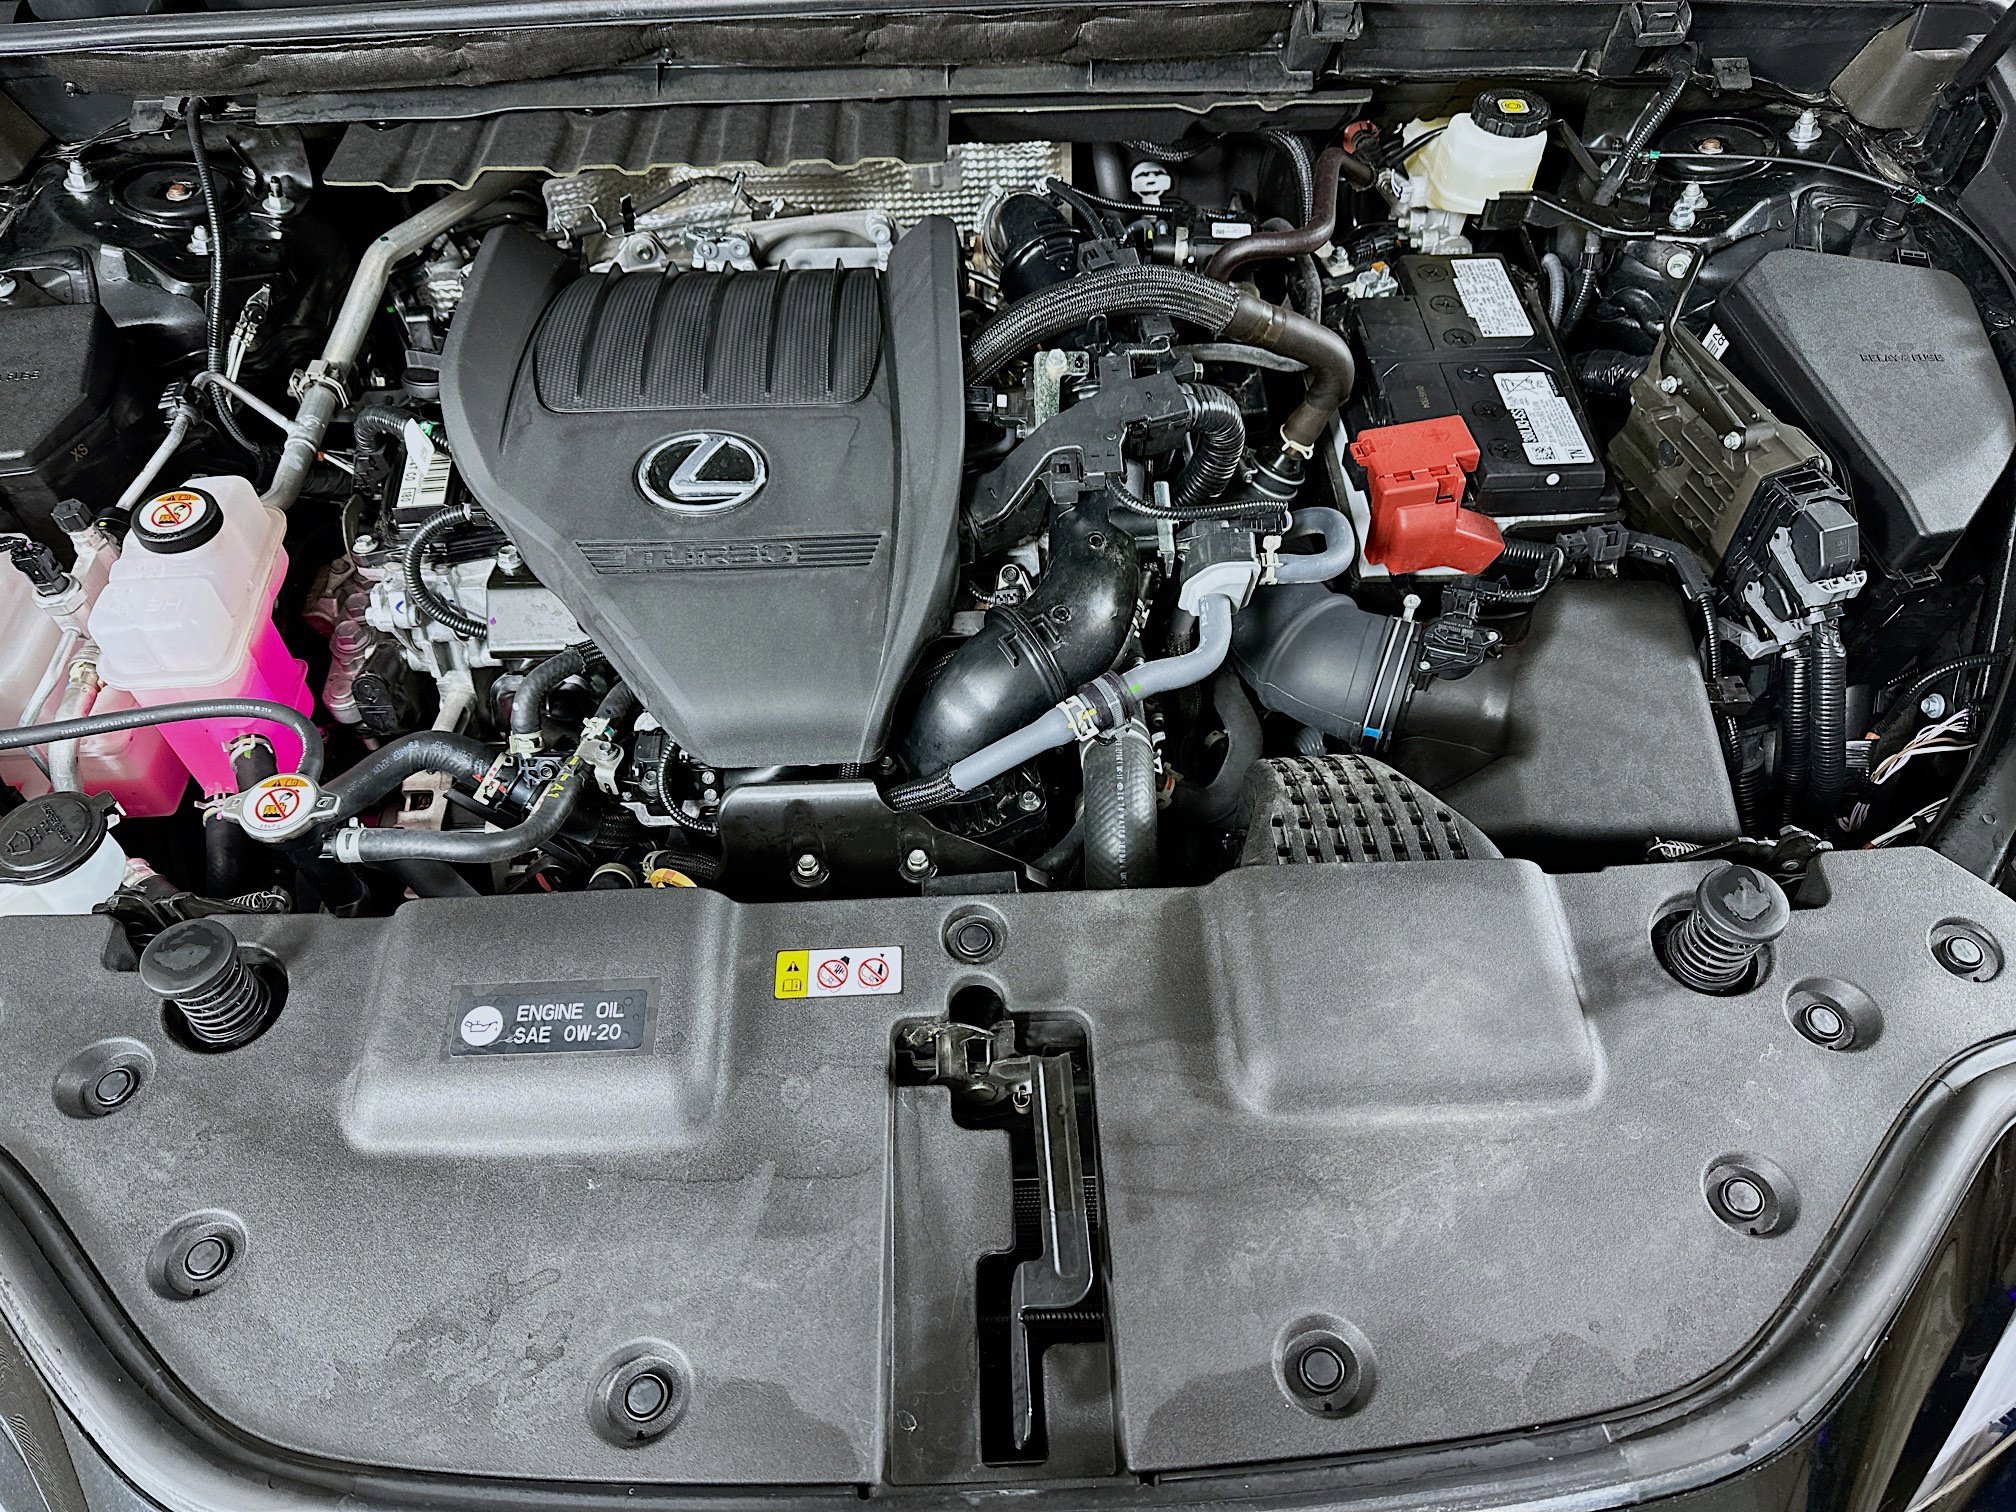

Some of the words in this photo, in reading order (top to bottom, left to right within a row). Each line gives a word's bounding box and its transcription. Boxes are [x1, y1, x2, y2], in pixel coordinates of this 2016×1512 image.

[1859, 353, 1899, 362] RELAY
[1911, 353, 1945, 362] FUSE
[626, 543, 793, 566] TURBO
[516, 1002, 585, 1022] ENGINE
[595, 1001, 625, 1019] OIL
[513, 1025, 553, 1045] SAE
[563, 1023, 623, 1043] 0W-20
